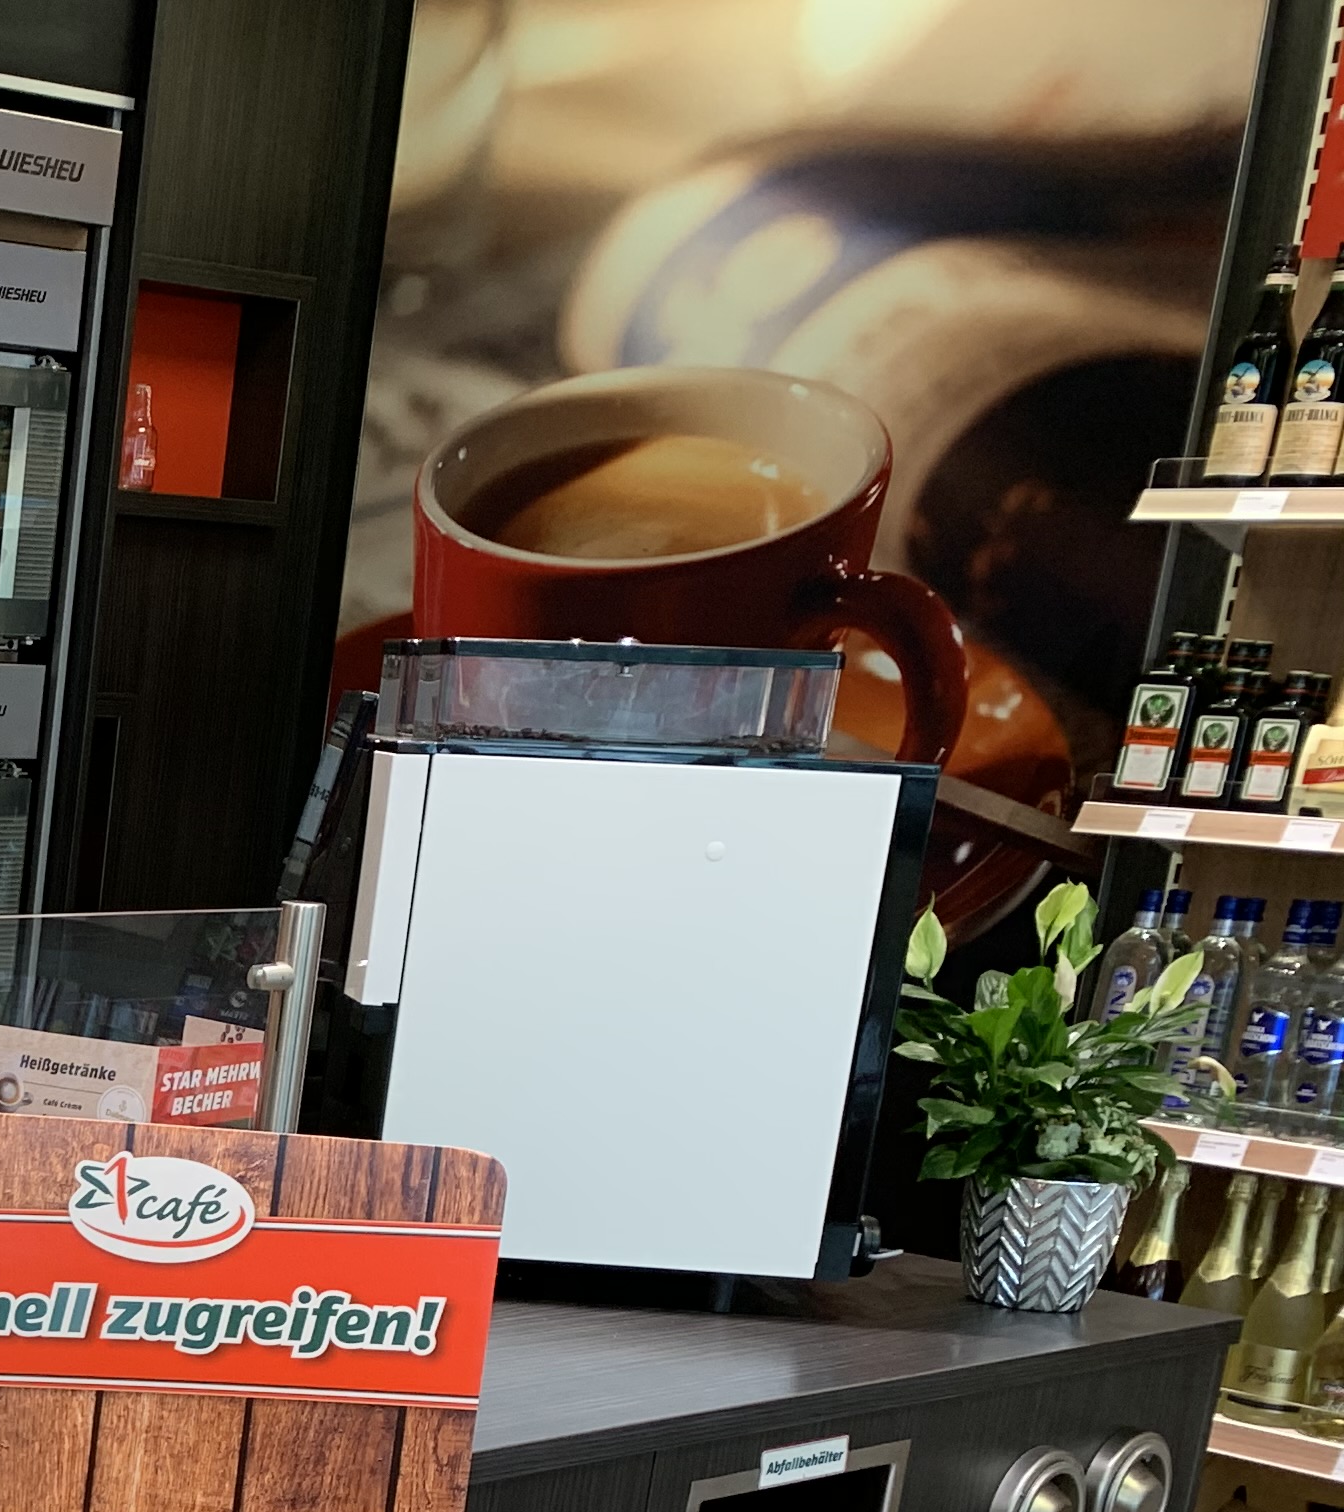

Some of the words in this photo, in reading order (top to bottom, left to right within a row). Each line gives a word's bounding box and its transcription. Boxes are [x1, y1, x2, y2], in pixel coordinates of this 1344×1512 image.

[20, 1054, 117, 1082] Heißgetränke
[161, 1070, 202, 1092] STAR
[43, 1098, 58, 1107] Café
[60, 1101, 82, 1111] Crème
[171, 1090, 234, 1116] BECHER
[134, 1184, 231, 1240] café
[101, 1285, 447, 1359] zugreifen!
[766, 1449, 845, 1477] Abfallbehälter
